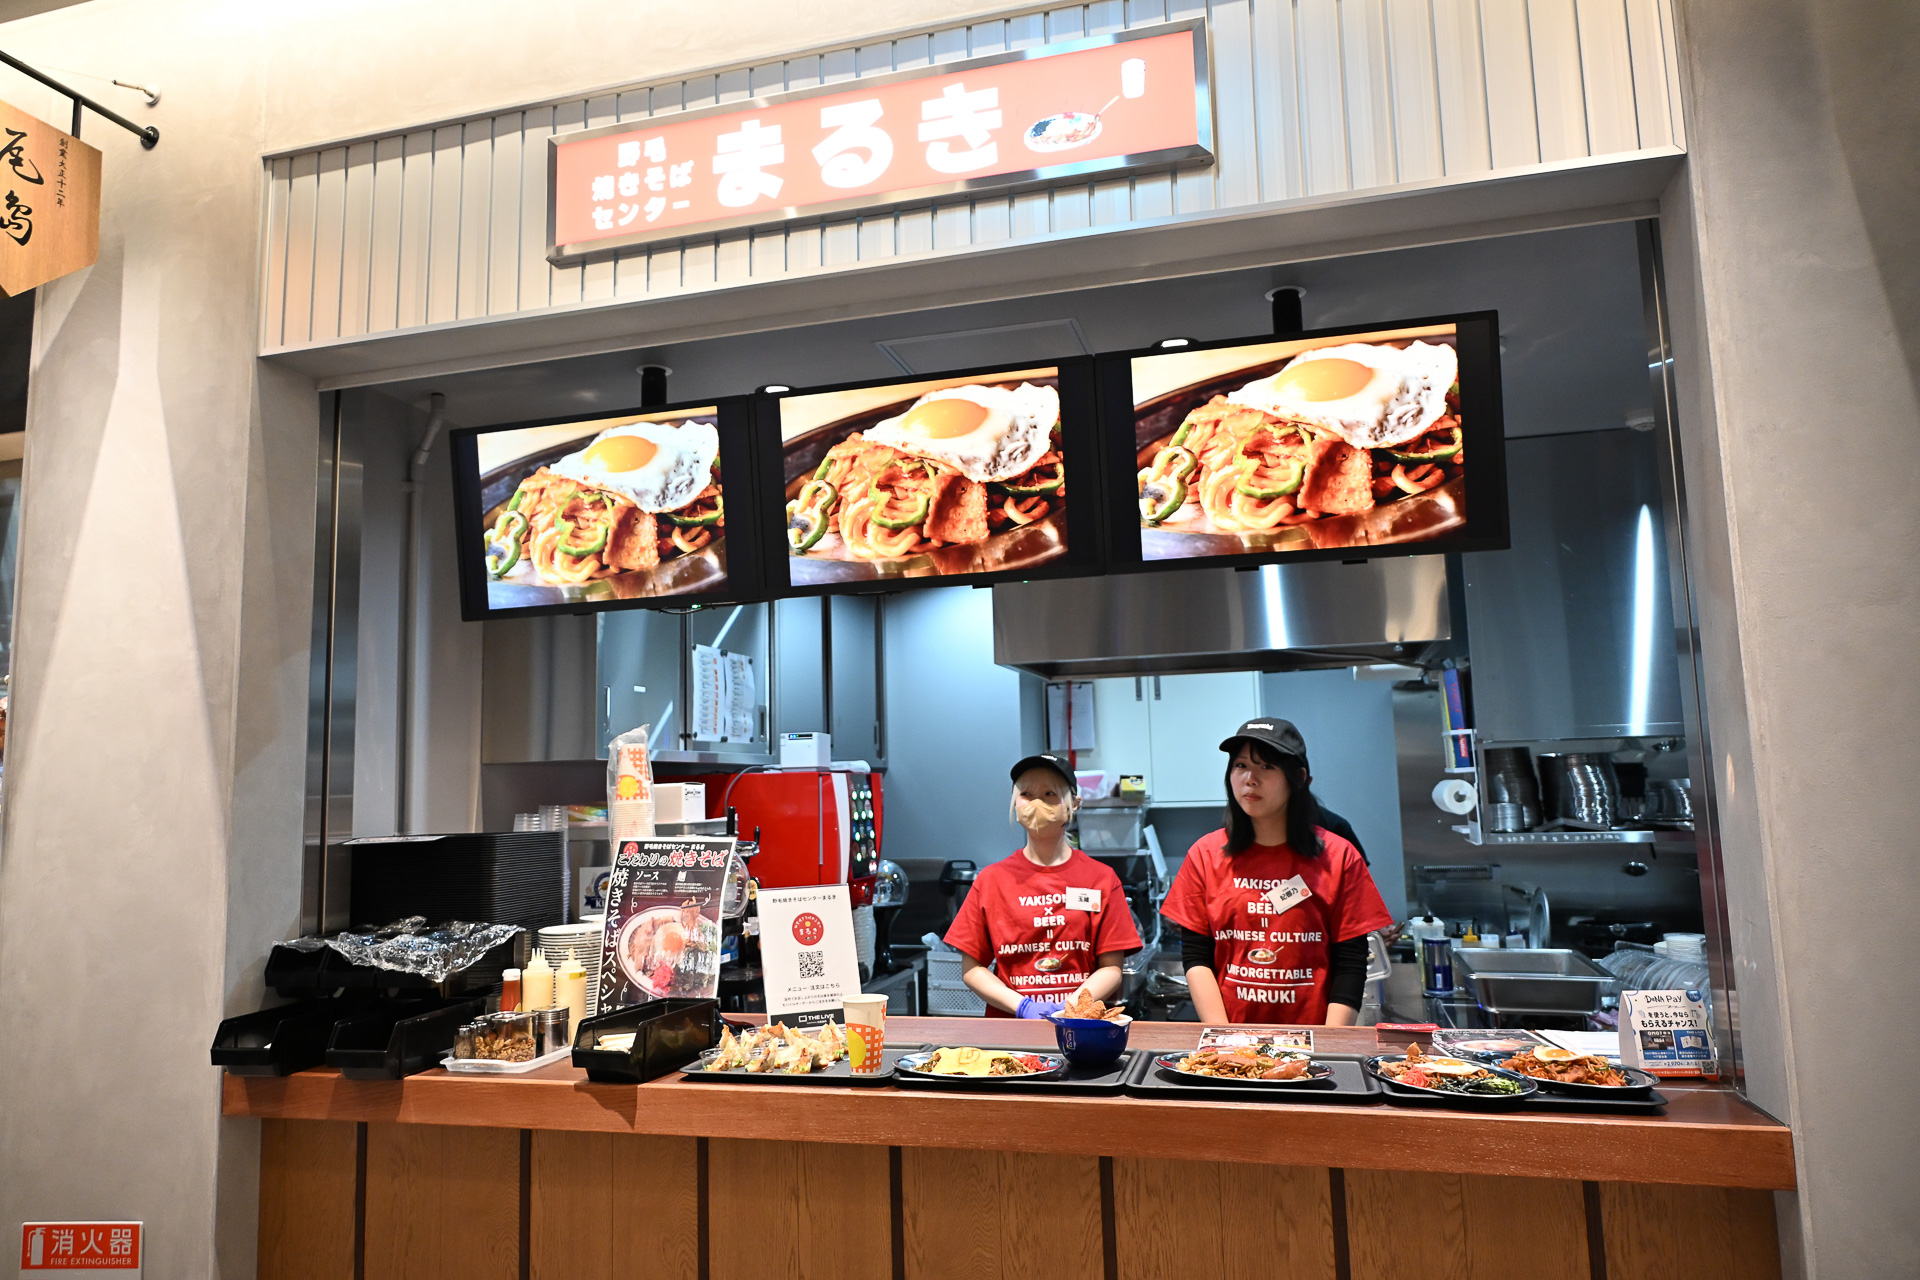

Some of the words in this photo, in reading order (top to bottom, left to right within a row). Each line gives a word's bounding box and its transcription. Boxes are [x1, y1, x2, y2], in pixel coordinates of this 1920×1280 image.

[712, 82, 1002, 207] まるき
[591, 196, 691, 230] センター
[635, 870, 660, 881] ソース
[1018, 893, 1067, 907] YAKISO
[1033, 915, 1066, 928] BEER
[1215, 929, 1266, 942] JAPANESE
[1269, 931, 1322, 943] CULTURE
[998, 942, 1051, 955] JAPANESE
[1226, 963, 1313, 980] UNFORGETTABLE
[1009, 972, 1090, 986] UNFORGETTABLE
[1236, 986, 1296, 1004] MARUKI
[1665, 994, 1682, 1003] Pay
[1647, 1010, 1689, 1019] を使うと、今なら
[51, 1228, 133, 1255] 消火器
[50, 1257, 68, 1265] FIRE
[70, 1257, 132, 1265] EXTINGUISHER
